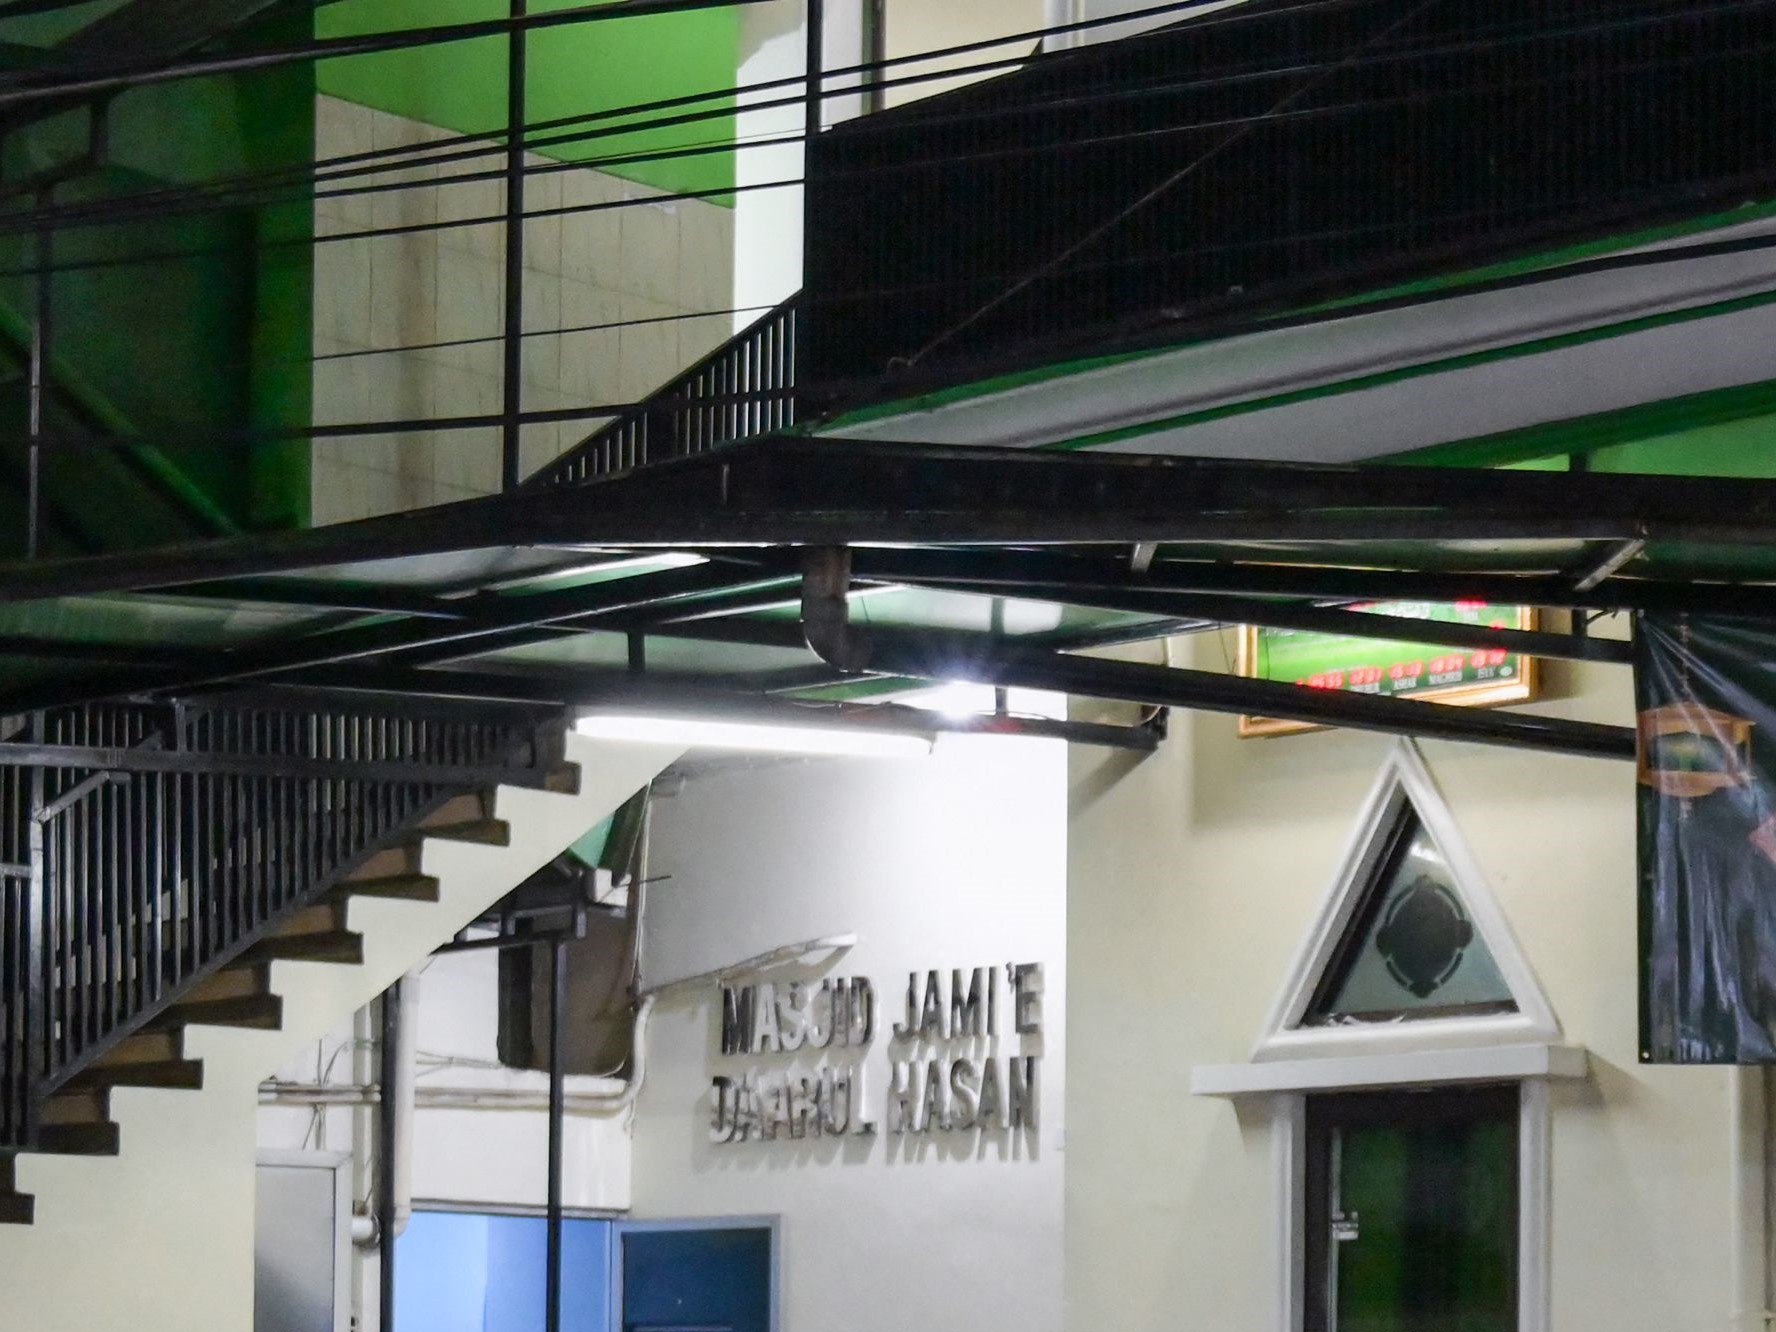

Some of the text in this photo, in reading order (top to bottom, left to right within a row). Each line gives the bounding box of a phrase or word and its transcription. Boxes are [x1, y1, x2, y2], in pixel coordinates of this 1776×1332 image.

[721, 962, 1044, 1055] MASJID JAMI'E
[886, 1056, 1041, 1134] HASAN
